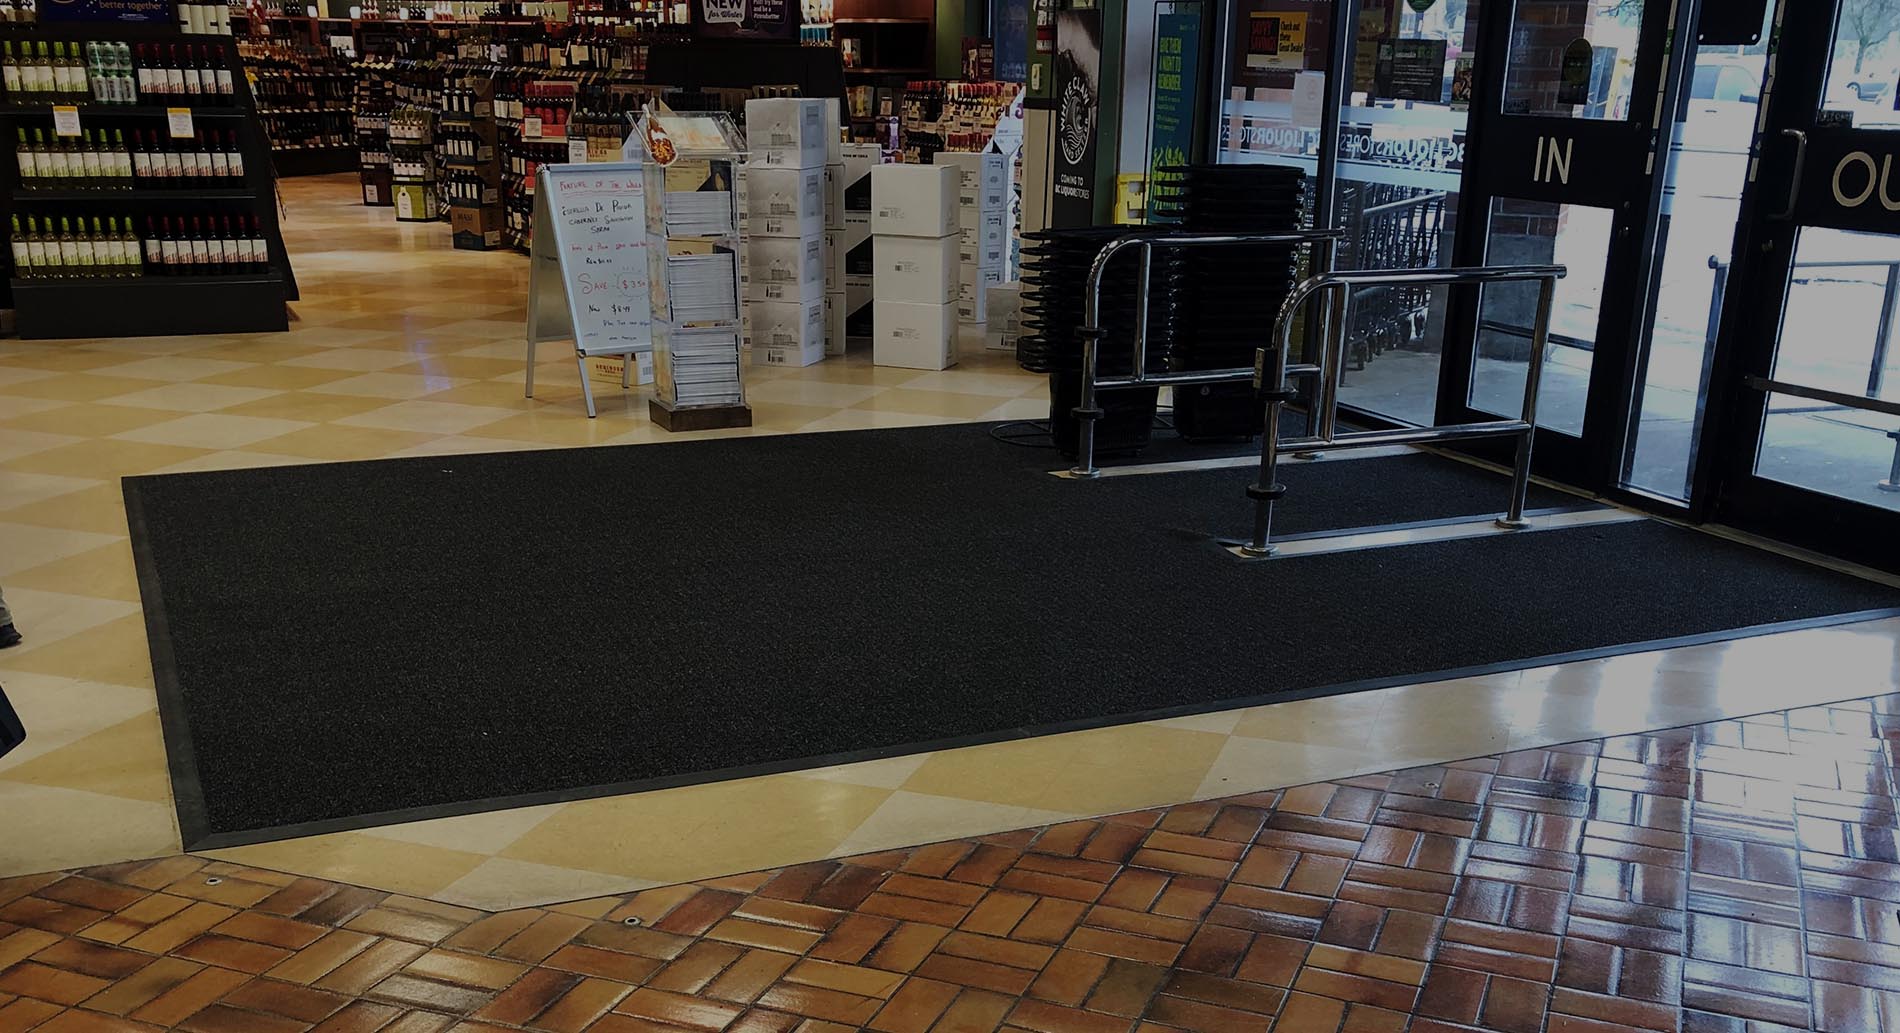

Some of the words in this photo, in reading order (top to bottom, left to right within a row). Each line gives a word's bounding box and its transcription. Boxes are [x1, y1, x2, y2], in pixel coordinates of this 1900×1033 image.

[99, 1, 127, 9] better
[128, 1, 161, 11] together
[706, 0, 741, 8] NEW
[1060, 81, 1073, 131] WHITE
[1072, 76, 1090, 105] CLAW
[1533, 135, 1574, 185] IN
[1060, 173, 1077, 186] COMING
[1077, 175, 1084, 187] TO
